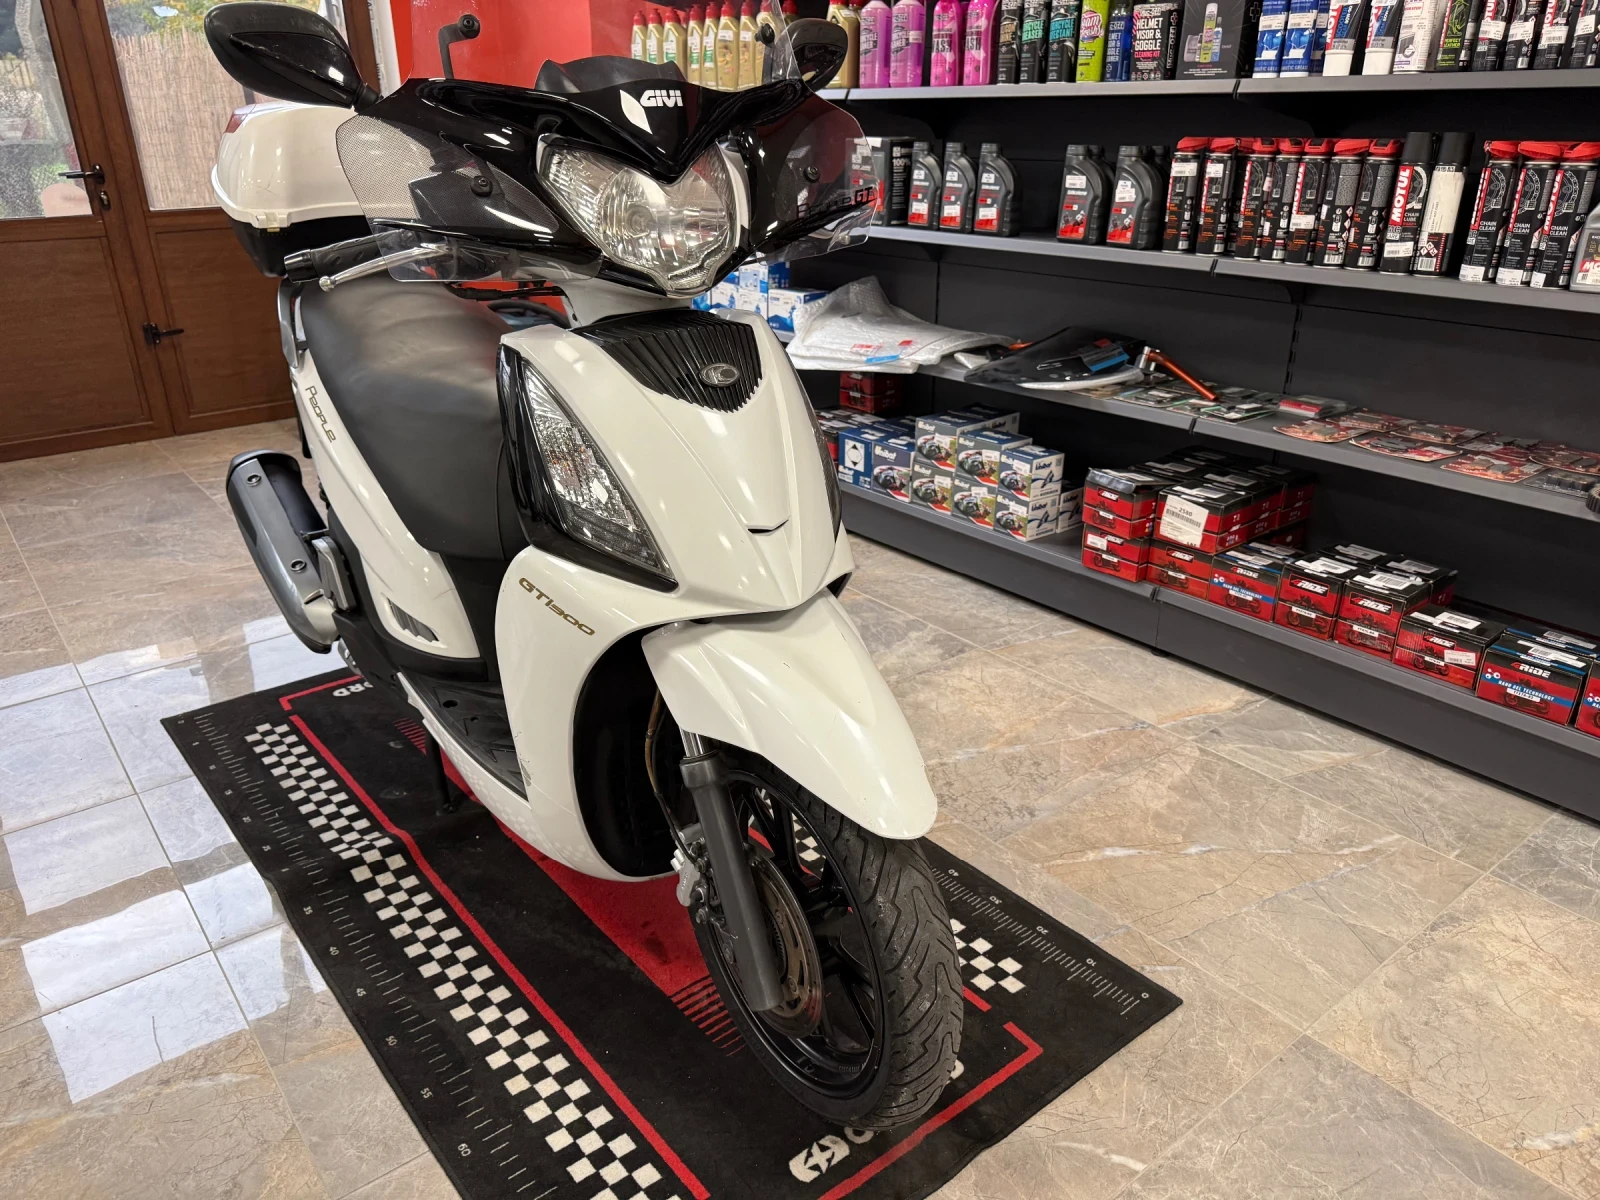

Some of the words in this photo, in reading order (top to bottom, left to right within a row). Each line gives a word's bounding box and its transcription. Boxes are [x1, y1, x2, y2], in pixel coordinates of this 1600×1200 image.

[1137, 18, 1163, 29] HELMET
[1136, 30, 1154, 39] VISOR
[1155, 29, 1162, 38] &
[1134, 40, 1161, 50] GOGGLE
[640, 90, 683, 107] GIVI
[1391, 168, 1410, 222] MOTUL
[875, 445, 897, 460] Unibat
[1291, 579, 1328, 594] 4RIDE
[1351, 597, 1392, 613] 4RIDE
[1511, 662, 1551, 678] 4RiDE
[1498, 680, 1511, 688] NANO
[1512, 683, 1521, 691] GEL
[1523, 687, 1555, 702] TECHNOLOGY
[989, 895, 1002, 904] 30
[303, 906, 313, 915] 35
[1036, 925, 1049, 935] 20
[329, 946, 340, 956] 40
[1086, 957, 1096, 967] 10
[355, 987, 366, 998] 45
[385, 1034, 397, 1046] 50
[420, 1087, 433, 1099] 55
[457, 1142, 472, 1157] 60
